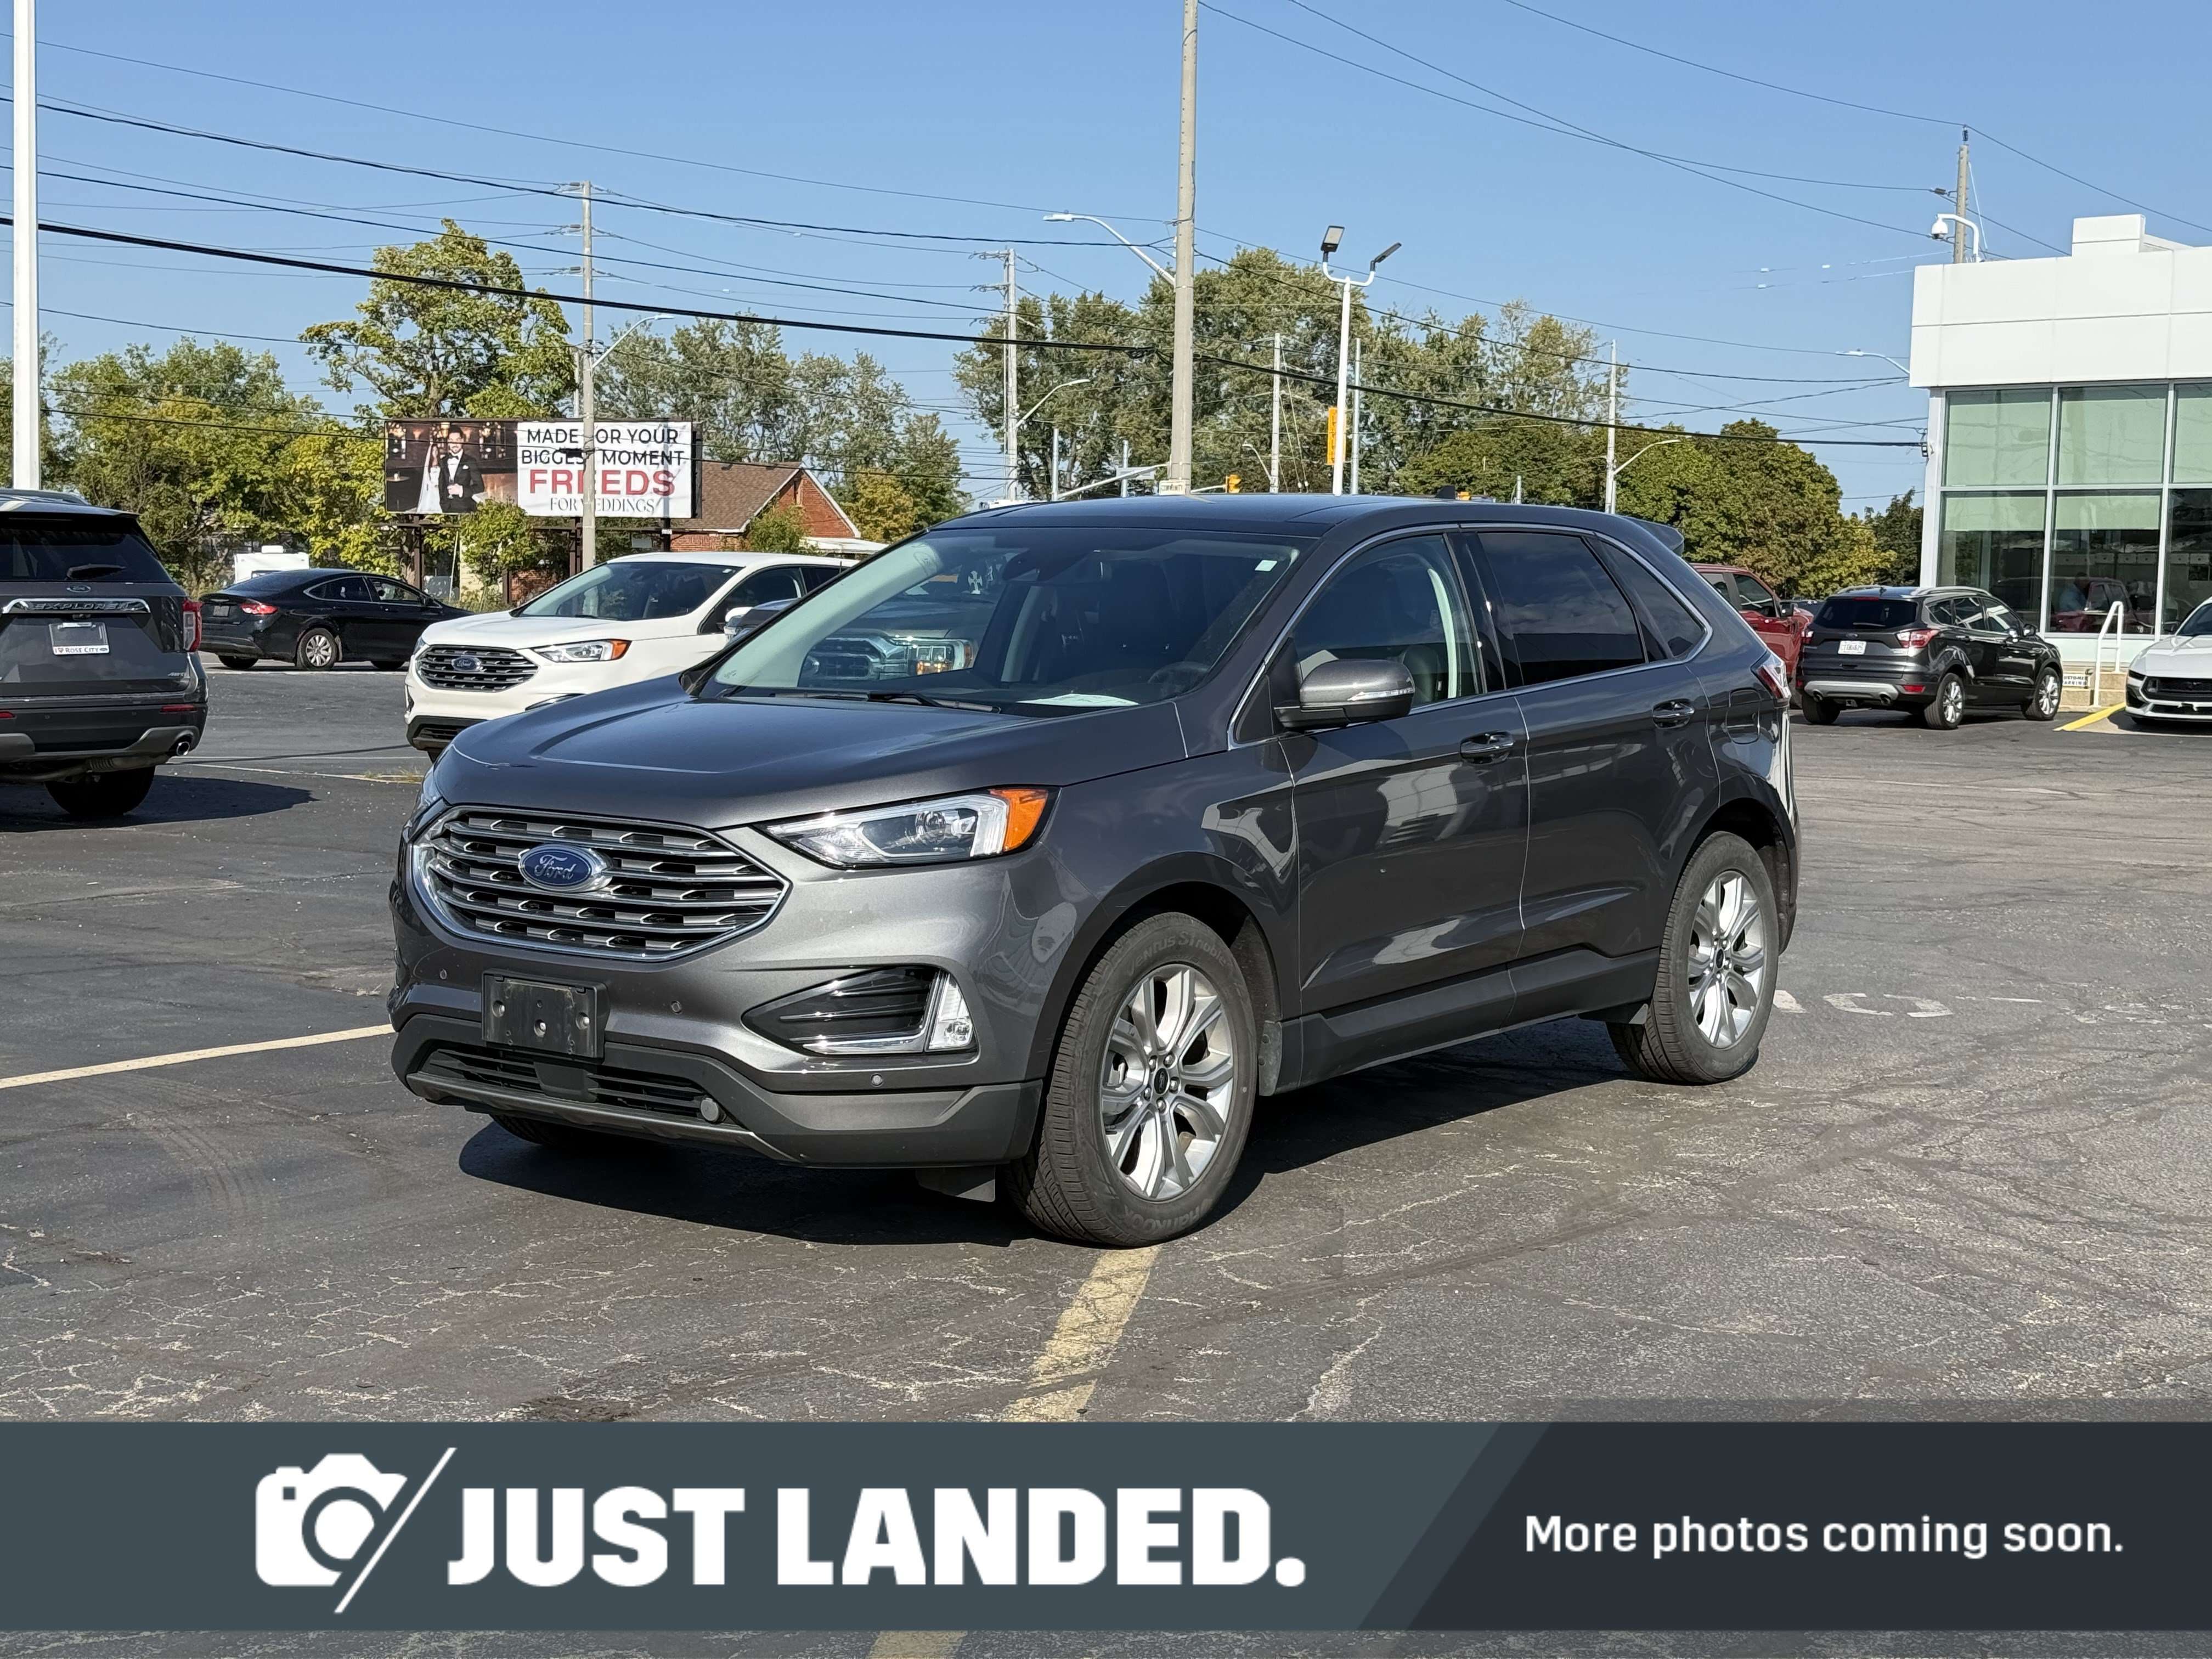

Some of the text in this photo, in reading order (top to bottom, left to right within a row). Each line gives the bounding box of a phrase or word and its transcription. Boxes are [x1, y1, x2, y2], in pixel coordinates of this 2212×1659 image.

[527, 428, 678, 444] MADE OR YOUR
[522, 449, 684, 465] BIGG MOMENT
[550, 497, 654, 513] FOR EDDINGS
[534, 854, 577, 879] Ford
